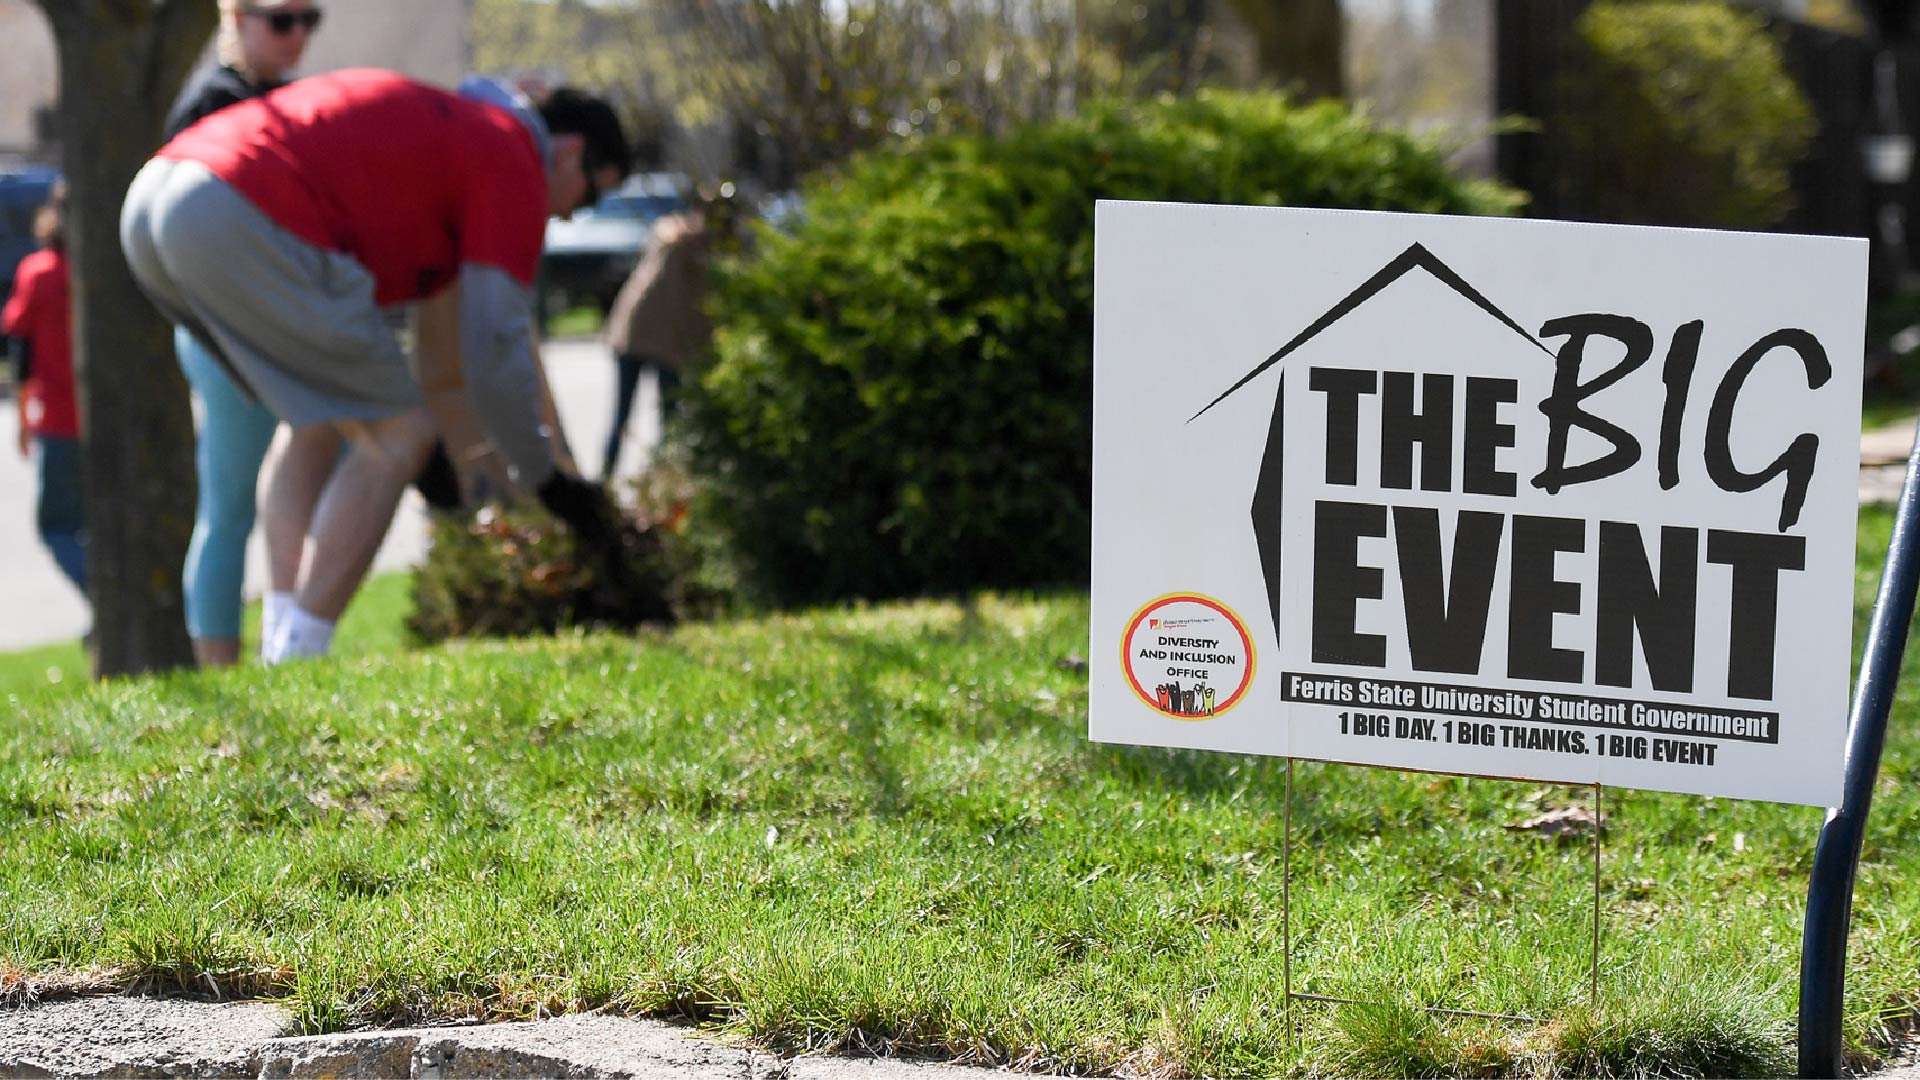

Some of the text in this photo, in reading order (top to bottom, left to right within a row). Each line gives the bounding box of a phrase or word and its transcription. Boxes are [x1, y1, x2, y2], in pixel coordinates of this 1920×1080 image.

[1309, 313, 1832, 532] THE BIG
[1312, 501, 1806, 700] EVENT
[1140, 649, 1236, 664] AND INCLUSION
[1158, 636, 1219, 649] DIVERSITY
[1166, 667, 1208, 679] OFFICE
[1290, 677, 1770, 738] Ferris State University Student Government
[1338, 712, 1718, 766] 1 BIG DAY. 1 BIG THANKS. 1 BIG EVENT
